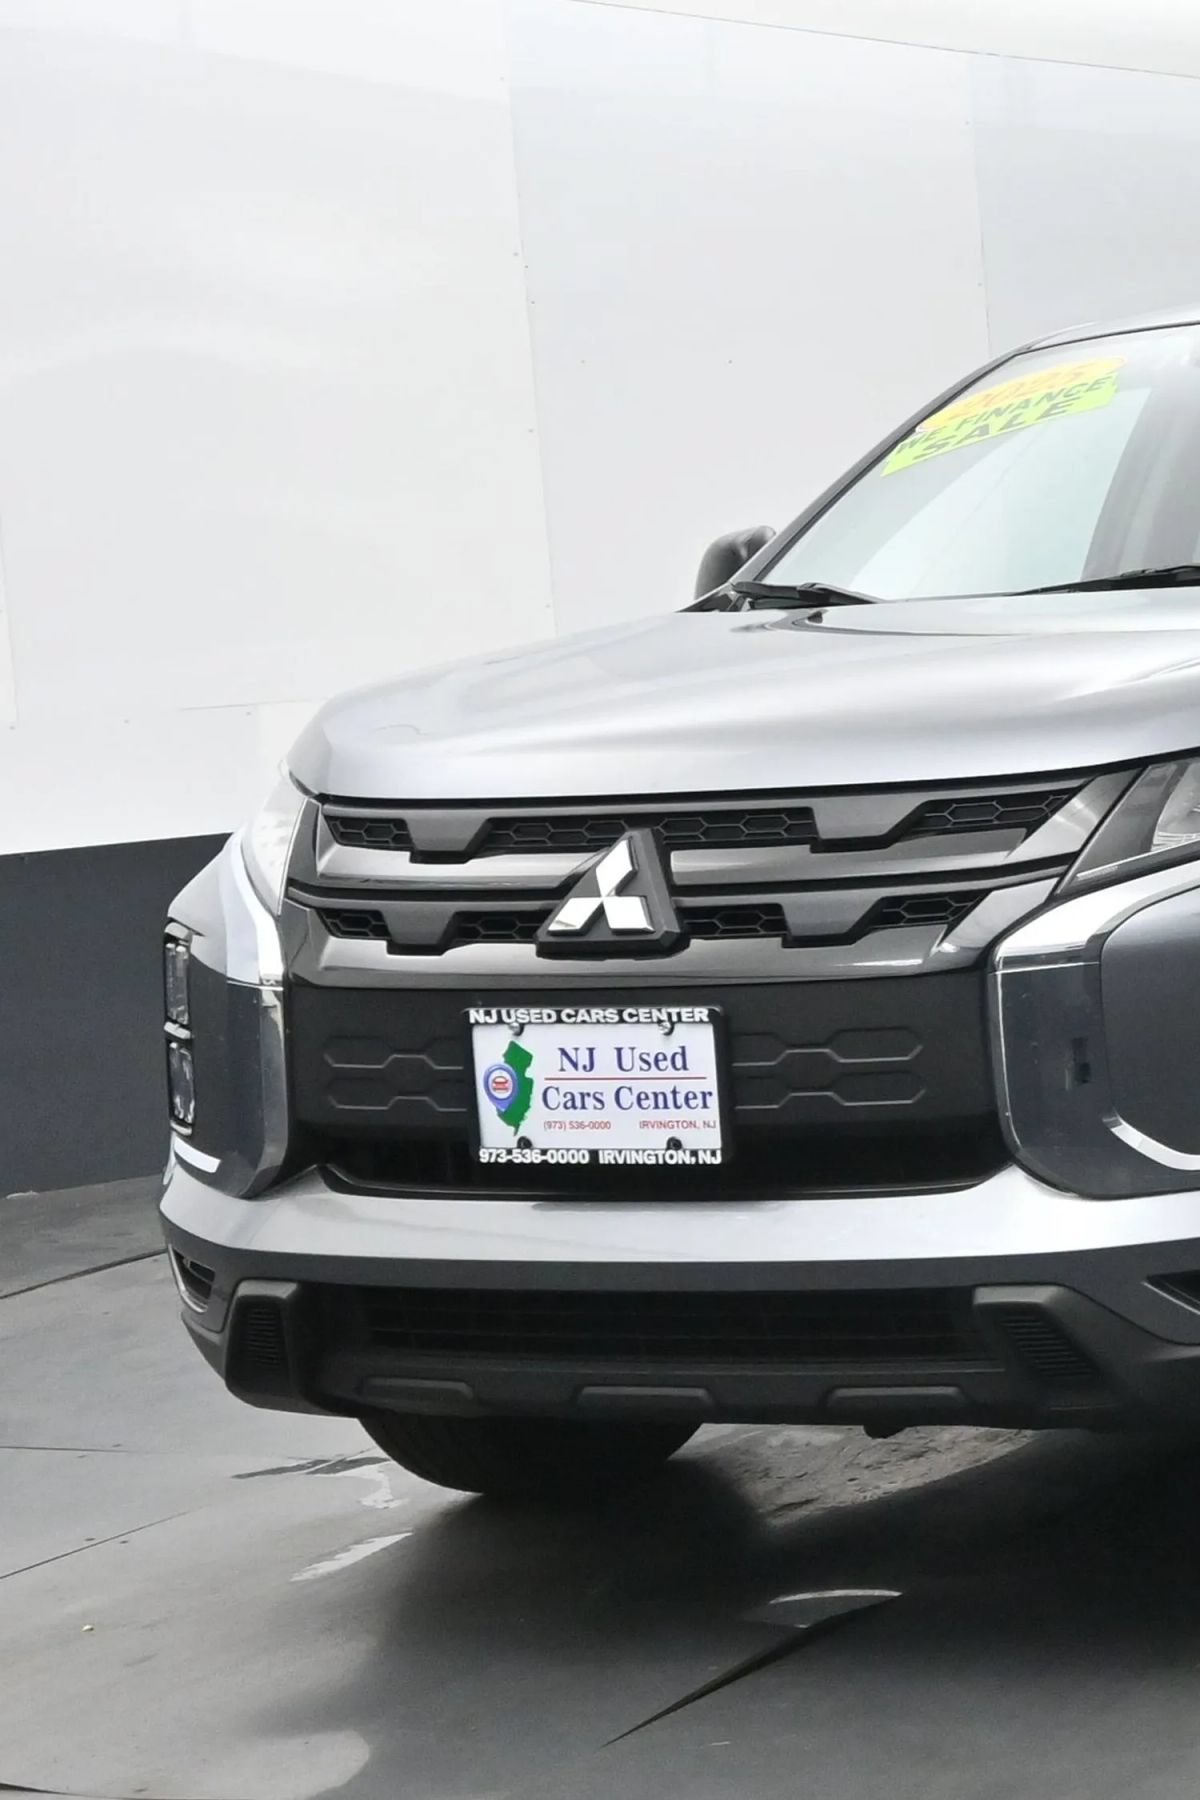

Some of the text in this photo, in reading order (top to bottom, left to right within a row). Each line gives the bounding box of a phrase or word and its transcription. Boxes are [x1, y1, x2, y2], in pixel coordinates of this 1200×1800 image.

[955, 375, 1112, 431] FINANCE
[912, 397, 1081, 460] SALE
[469, 1008, 709, 1023] NJ USED CARS CENTER
[557, 1046, 689, 1072] NJ Used
[541, 1085, 713, 1111] Cars Center
[543, 1121, 611, 1131] (973) 536-0000
[702, 1120, 716, 1129] NJ
[479, 1149, 722, 1165] 973-536-0000 IRVINGTON, NJ
